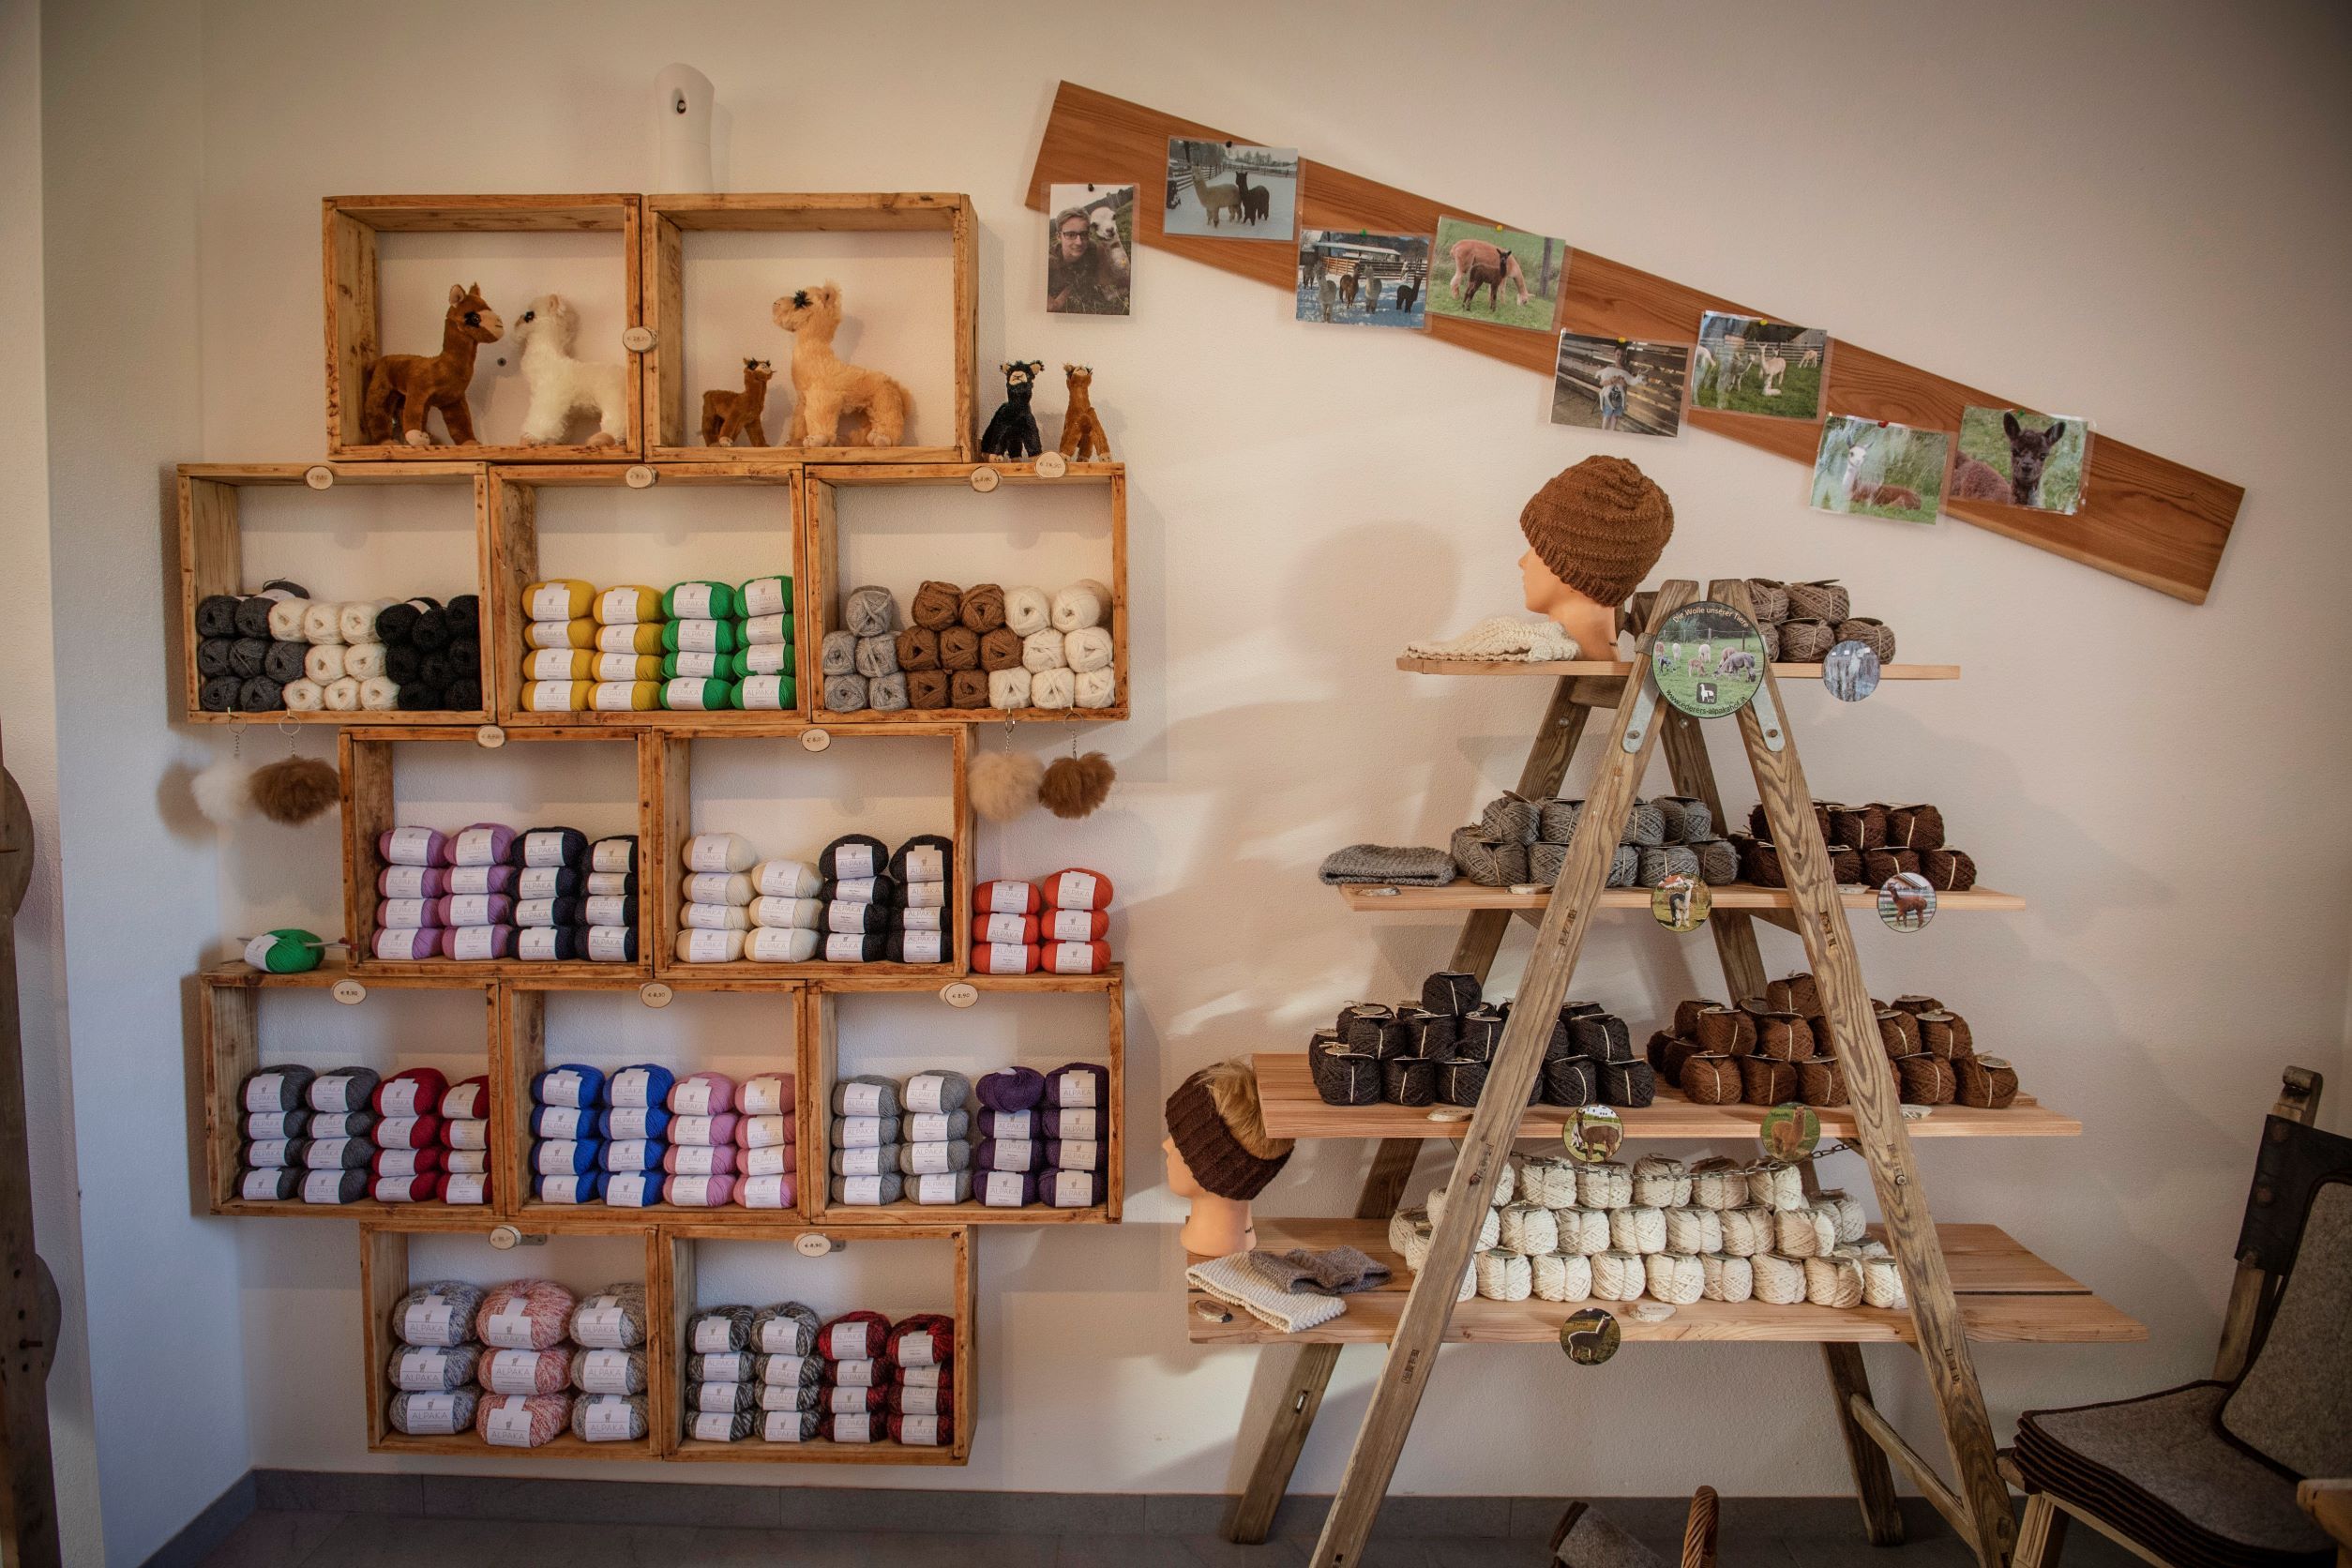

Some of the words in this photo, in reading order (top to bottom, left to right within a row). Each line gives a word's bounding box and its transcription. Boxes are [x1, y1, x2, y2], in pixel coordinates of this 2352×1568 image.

[749, 596, 778, 605] ALPAKA
[1672, 612, 1684, 623] Die
[1685, 607, 1705, 616] Wolle
[1706, 608, 1733, 617] unserer
[1734, 612, 1749, 628] Tiere
[1666, 689, 1748, 716] www.ederers-alpakahof.at
[411, 1324, 444, 1333] ALPAKA
[590, 1424, 625, 1433] ALPAKA
